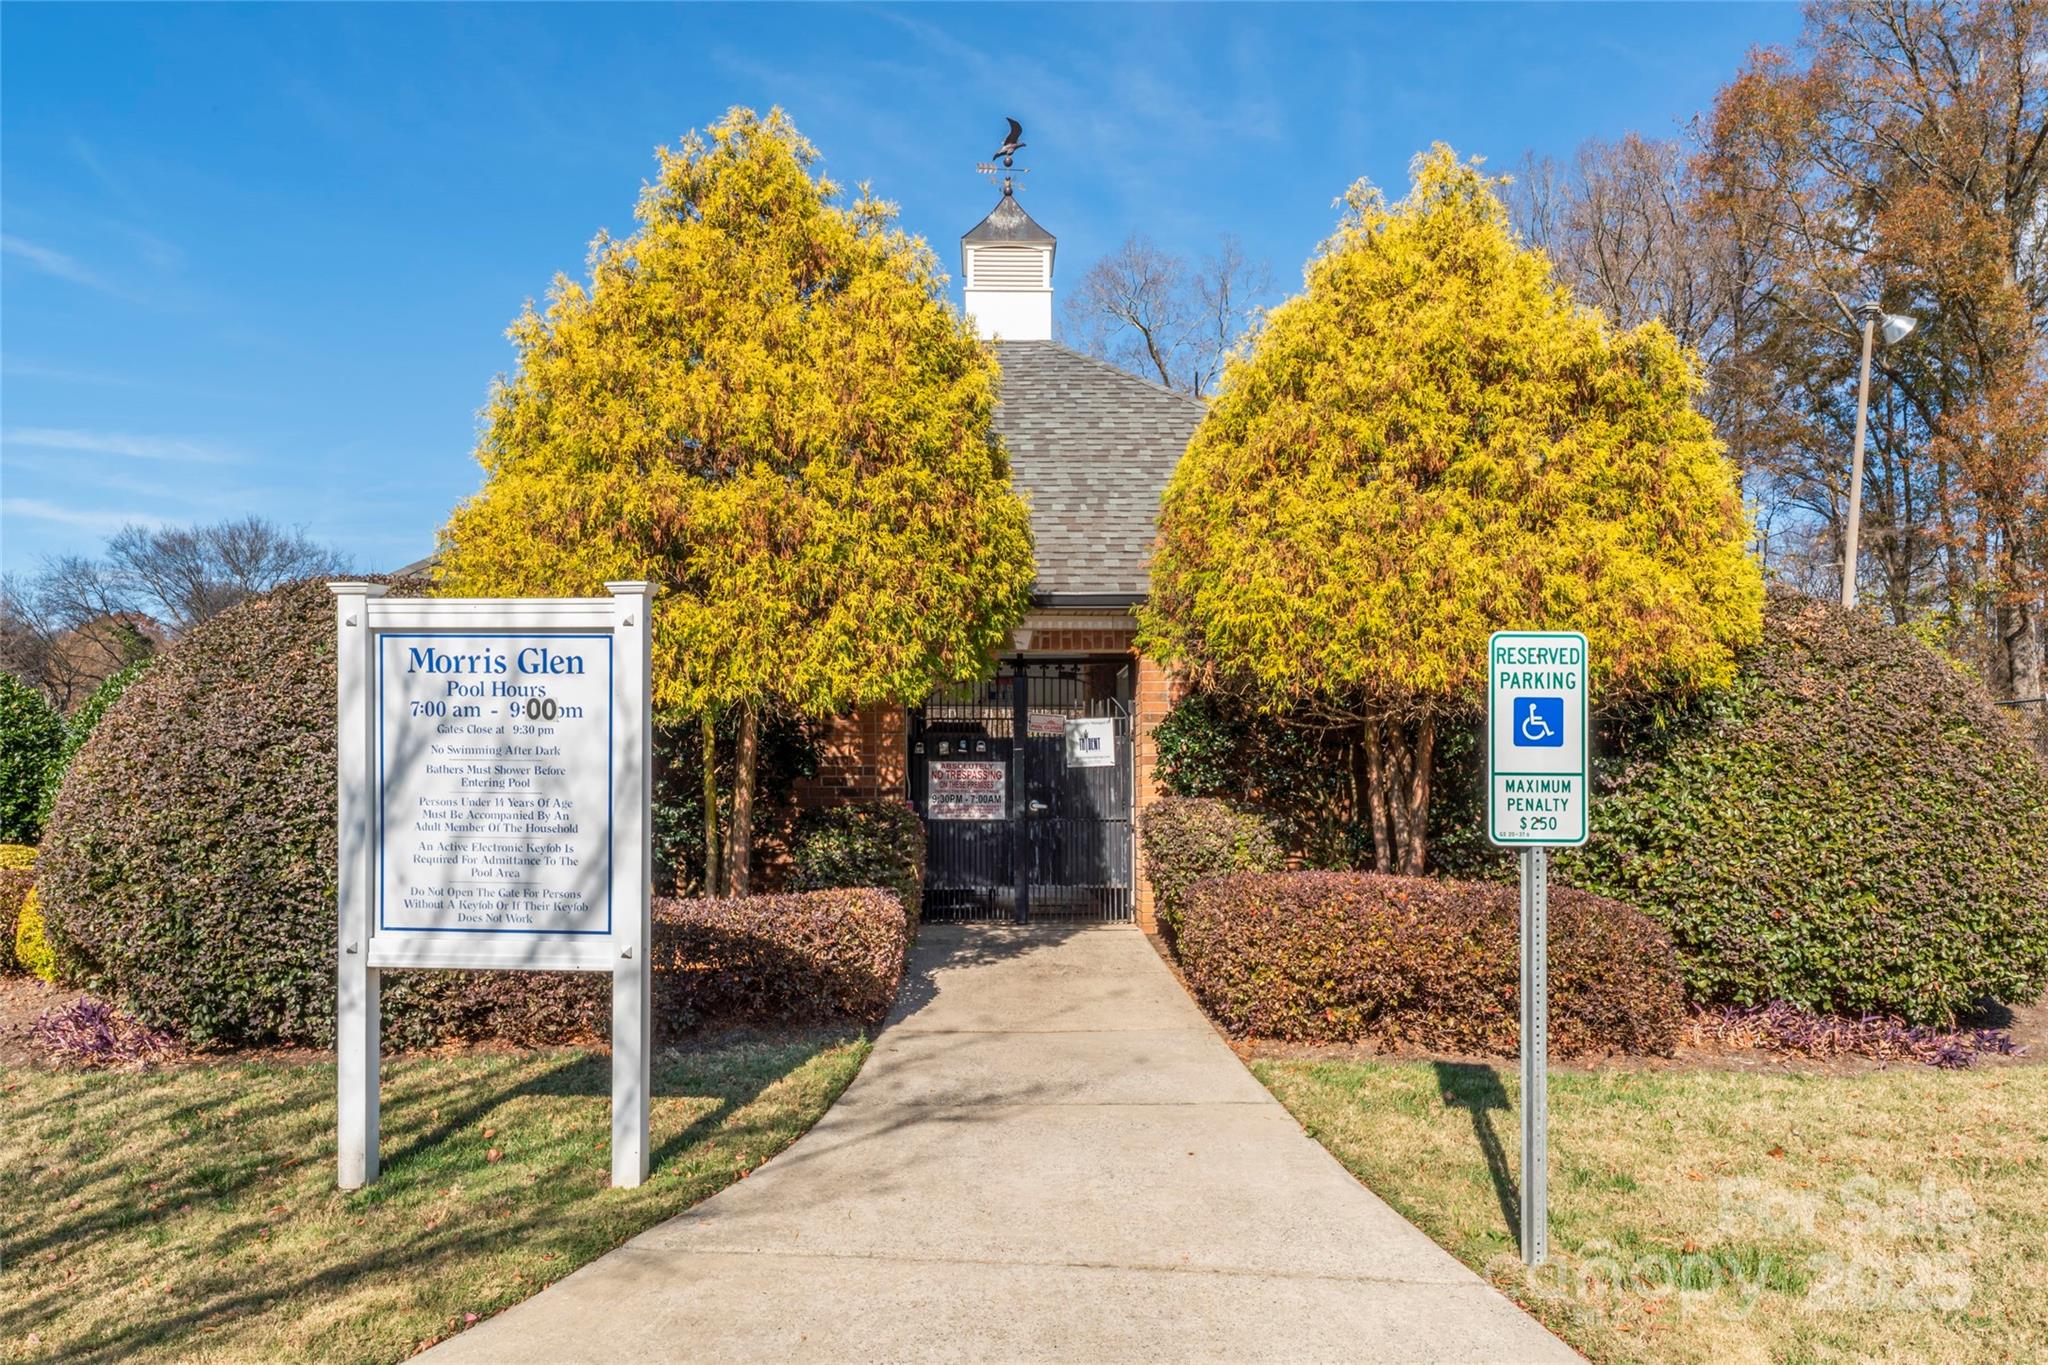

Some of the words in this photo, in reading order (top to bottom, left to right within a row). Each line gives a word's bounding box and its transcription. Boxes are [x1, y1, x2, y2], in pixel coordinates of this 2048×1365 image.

[408, 647, 507, 674] Morris
[517, 647, 585, 674] Glen
[1497, 647, 1580, 665] RESERVED
[1500, 672, 1576, 690] PARKING
[447, 681, 484, 697] Pool
[492, 681, 546, 697] Hours
[410, 701, 446, 717] 7:00
[453, 706, 481, 718] am
[437, 725, 464, 735] Gates
[467, 725, 492, 735] Close
[496, 725, 504, 734] at
[513, 725, 535, 734] 9:30
[538, 727, 554, 737] pm
[431, 745, 444, 754] No
[447, 745, 502, 756] Swimming
[505, 745, 532, 755] After
[535, 746, 560, 756] Dark
[426, 765, 464, 774] Bathers
[467, 765, 491, 775] Must
[494, 765, 531, 775] Shower
[534, 765, 566, 775] Before
[932, 771, 943, 779] NO
[946, 771, 1002, 779] TRESPASSING
[461, 778, 505, 789] Entering
[508, 778, 530, 788] Pool
[1505, 780, 1572, 793] MAXIMUM
[419, 797, 458, 807] Persons
[461, 797, 493, 807] Under
[495, 798, 504, 807] 14
[508, 798, 534, 808] Years
[538, 798, 549, 808] Of
[552, 799, 573, 809] Age
[932, 795, 962, 803] 9:30PM
[971, 795, 1001, 803] 7:00AM
[1507, 799, 1569, 812] PENALTY
[422, 809, 447, 819] Must
[450, 810, 464, 819] Be
[467, 810, 534, 822] Accompanied
[537, 811, 551, 822] By
[554, 811, 569, 820] An
[415, 822, 441, 832] Adult
[444, 823, 485, 832] Member
[488, 823, 500, 832] Of
[503, 824, 522, 833] The
[526, 824, 579, 834] Household
[1520, 817, 1557, 830] $250
[418, 842, 434, 851] An
[437, 842, 468, 852] Active
[472, 842, 523, 852] Electronic
[526, 843, 561, 856] Keyfob
[565, 843, 574, 853] Is
[413, 855, 458, 866] Required
[462, 855, 478, 865] For
[481, 856, 541, 866] Admittance
[544, 856, 557, 866] To
[559, 856, 579, 866] The
[471, 868, 493, 877] Pool
[496, 868, 520, 878] Area
[410, 887, 425, 896] Do
[428, 887, 444, 897] Not
[447, 888, 473, 899] Open
[475, 888, 495, 897] The
[498, 888, 520, 898] Gate
[523, 889, 539, 898] For
[542, 889, 582, 899] Persons
[404, 900, 444, 909] Without
[447, 900, 456, 909] A
[459, 900, 493, 913] Keyfob
[496, 901, 509, 910] Or
[512, 901, 522, 911] If
[523, 902, 549, 911] Their
[553, 902, 588, 915] Keyfob
[458, 913, 483, 923] Does
[486, 914, 503, 923] Not
[505, 914, 533, 924] Work
